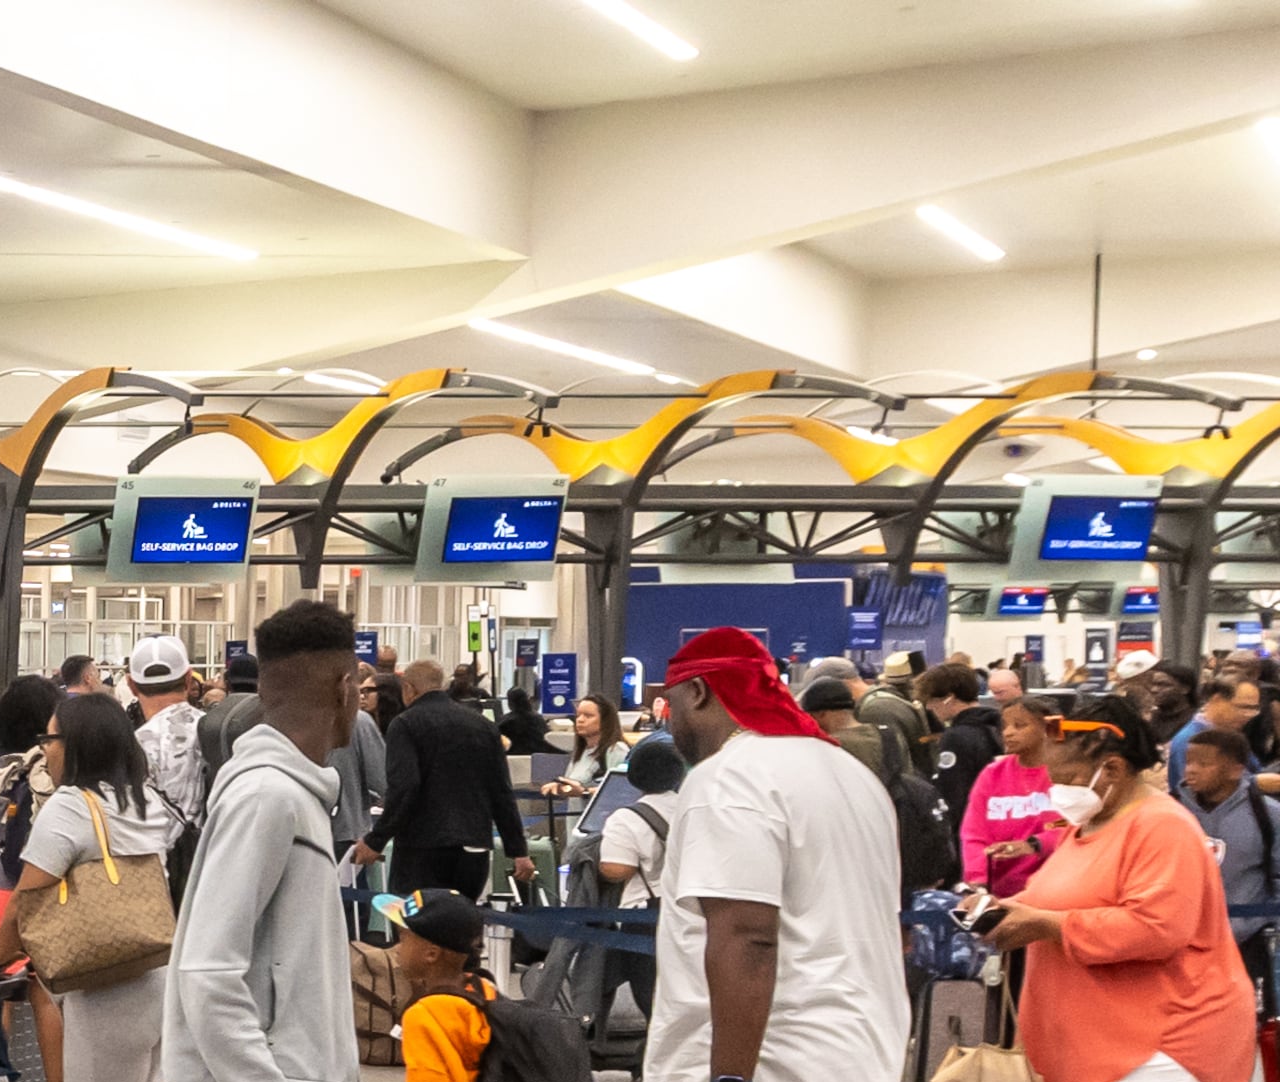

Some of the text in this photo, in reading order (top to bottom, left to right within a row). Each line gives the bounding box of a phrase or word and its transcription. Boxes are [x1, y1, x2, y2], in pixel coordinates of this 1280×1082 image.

[121, 480, 134, 490] 45
[242, 480, 256, 490] 46
[434, 478, 448, 487] 47
[141, 542, 239, 552] SELF-SERVICE BAG DROP
[452, 540, 549, 552] SELF-SERVICE BAG DROP
